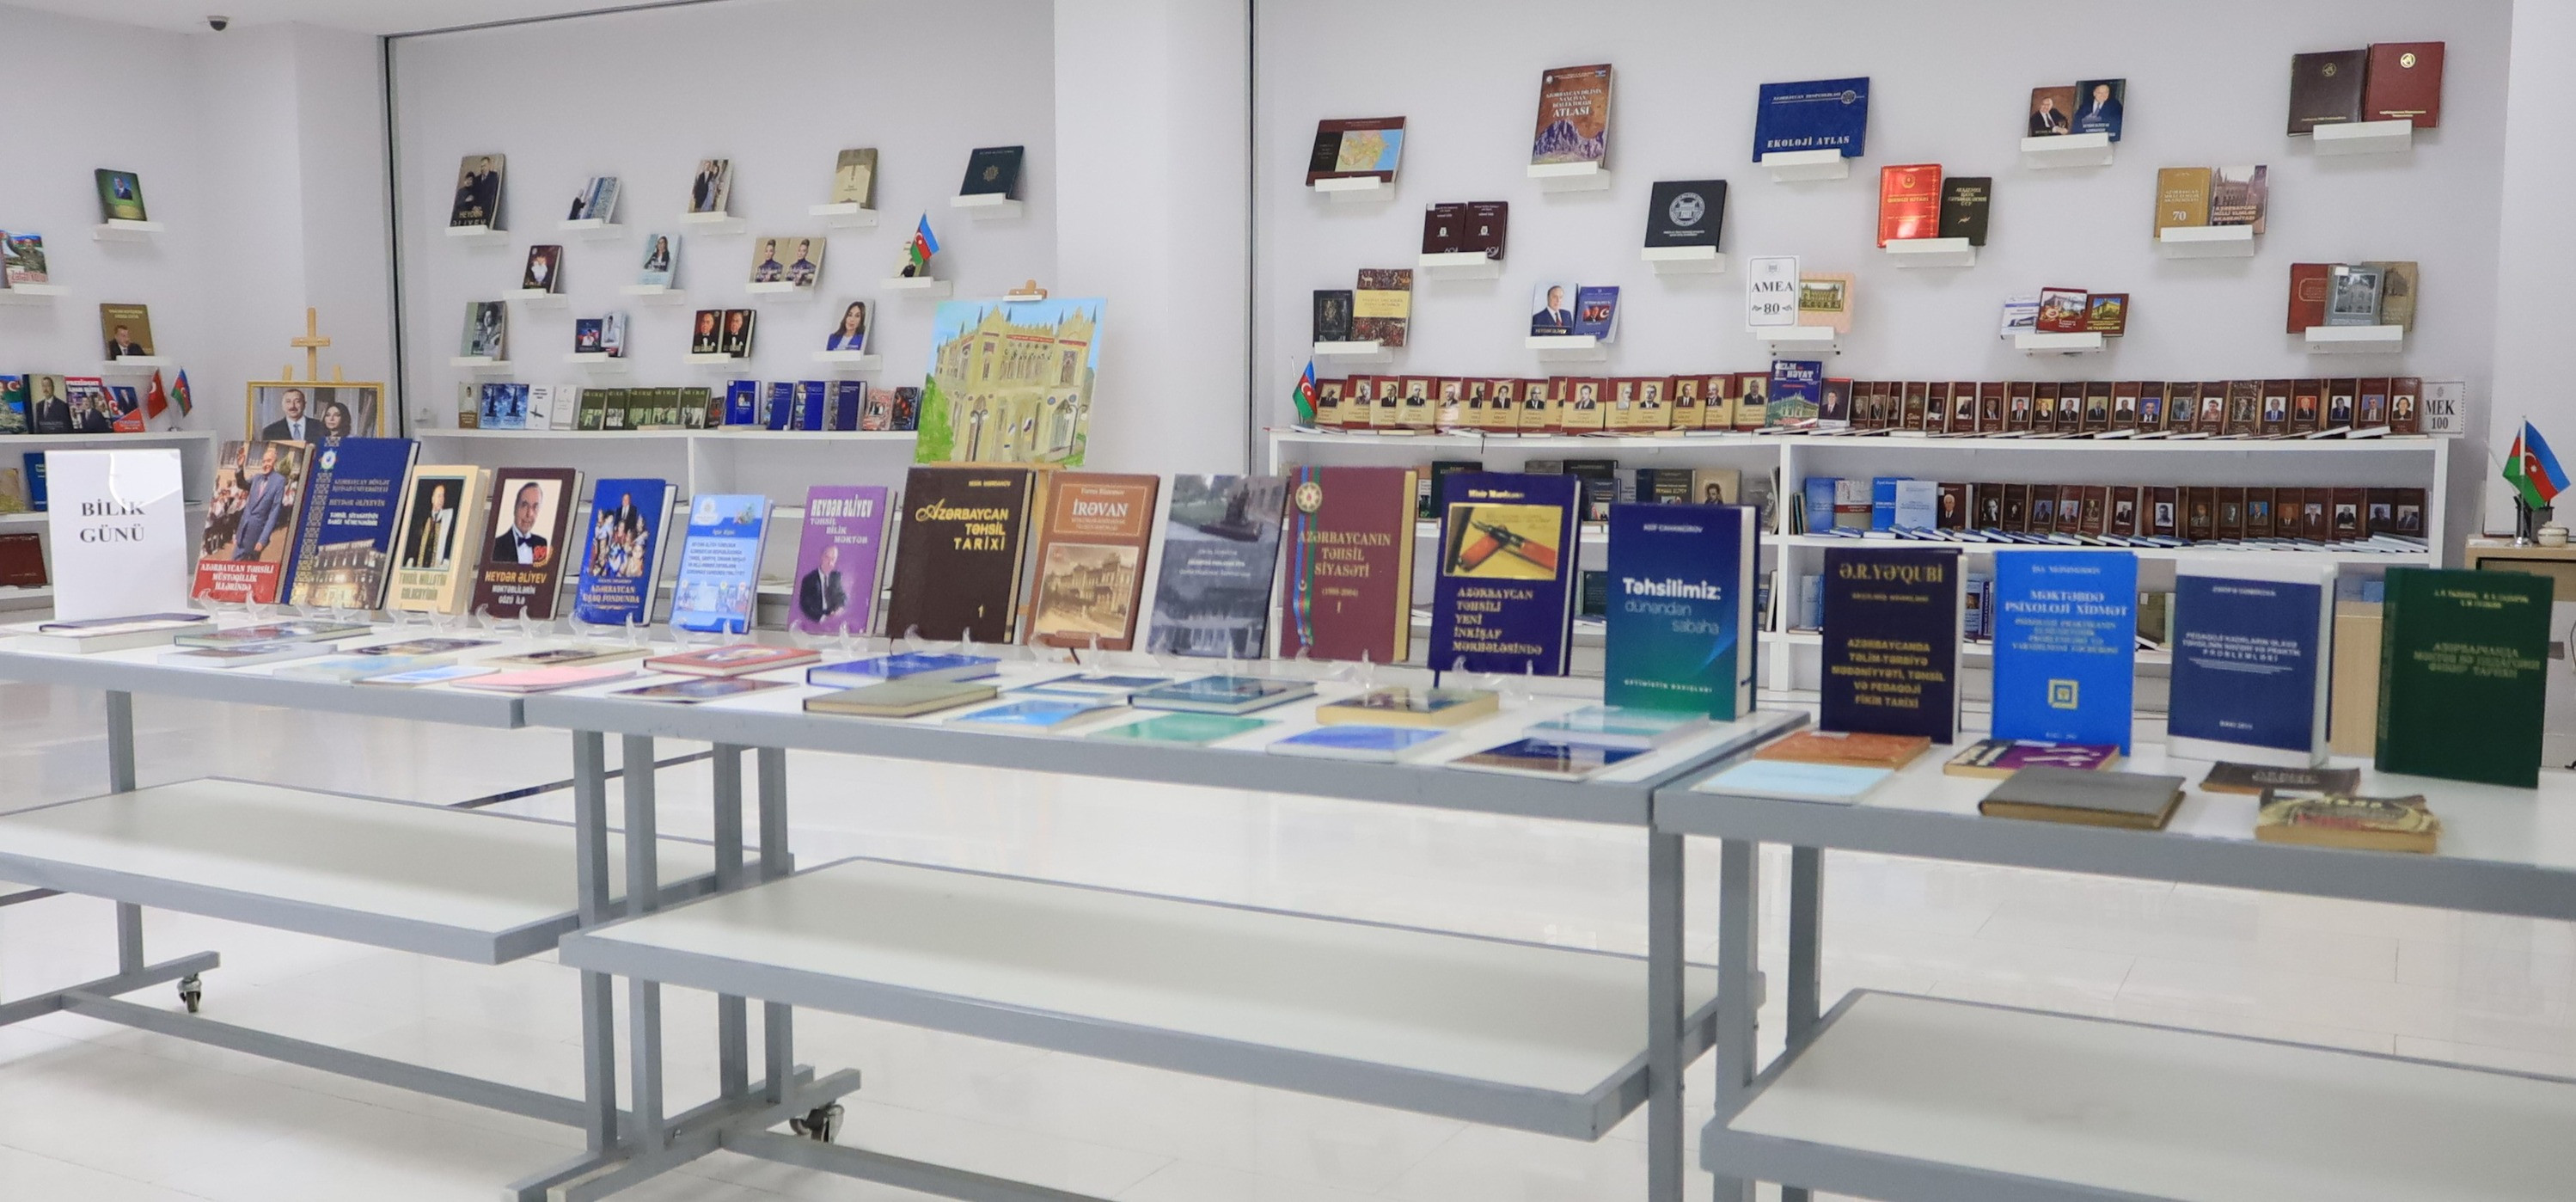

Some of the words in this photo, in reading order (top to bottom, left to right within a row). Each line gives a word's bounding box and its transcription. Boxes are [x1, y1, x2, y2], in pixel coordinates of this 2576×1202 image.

[1767, 137, 1812, 148] EKOLOJİ
[1816, 136, 1850, 145] ATLAS
[2173, 211, 2187, 221] 70
[1752, 281, 1794, 292] AMEA
[1764, 303, 1780, 315] 80
[2425, 400, 2456, 415] MEK
[2432, 417, 2449, 429] 100
[82, 499, 145, 516] BİLİK
[915, 498, 1009, 522] AZƏRBAYCAN
[1072, 498, 1129, 517] İRƏVAN
[80, 524, 144, 543] GÜNÜ
[965, 522, 1006, 536] TƏHSİL
[953, 536, 1006, 550] TARİXİ
[1298, 530, 1392, 546] AZƏRBAYCANIN
[1321, 547, 1365, 561] TƏHSİL
[1314, 561, 1370, 577] SİYASƏTİ
[485, 570, 516, 582] HEYDƏR
[517, 570, 548, 584] ƏLİYEV
[1457, 588, 1533, 599] AZƏRBAYCAN
[1622, 577, 1722, 600] Təhsilimiz:
[977, 604, 984, 618] 1
[1625, 600, 1692, 616] dünəndən
[1455, 613, 1483, 625] YENİ
[1672, 618, 1720, 635] sabaha
